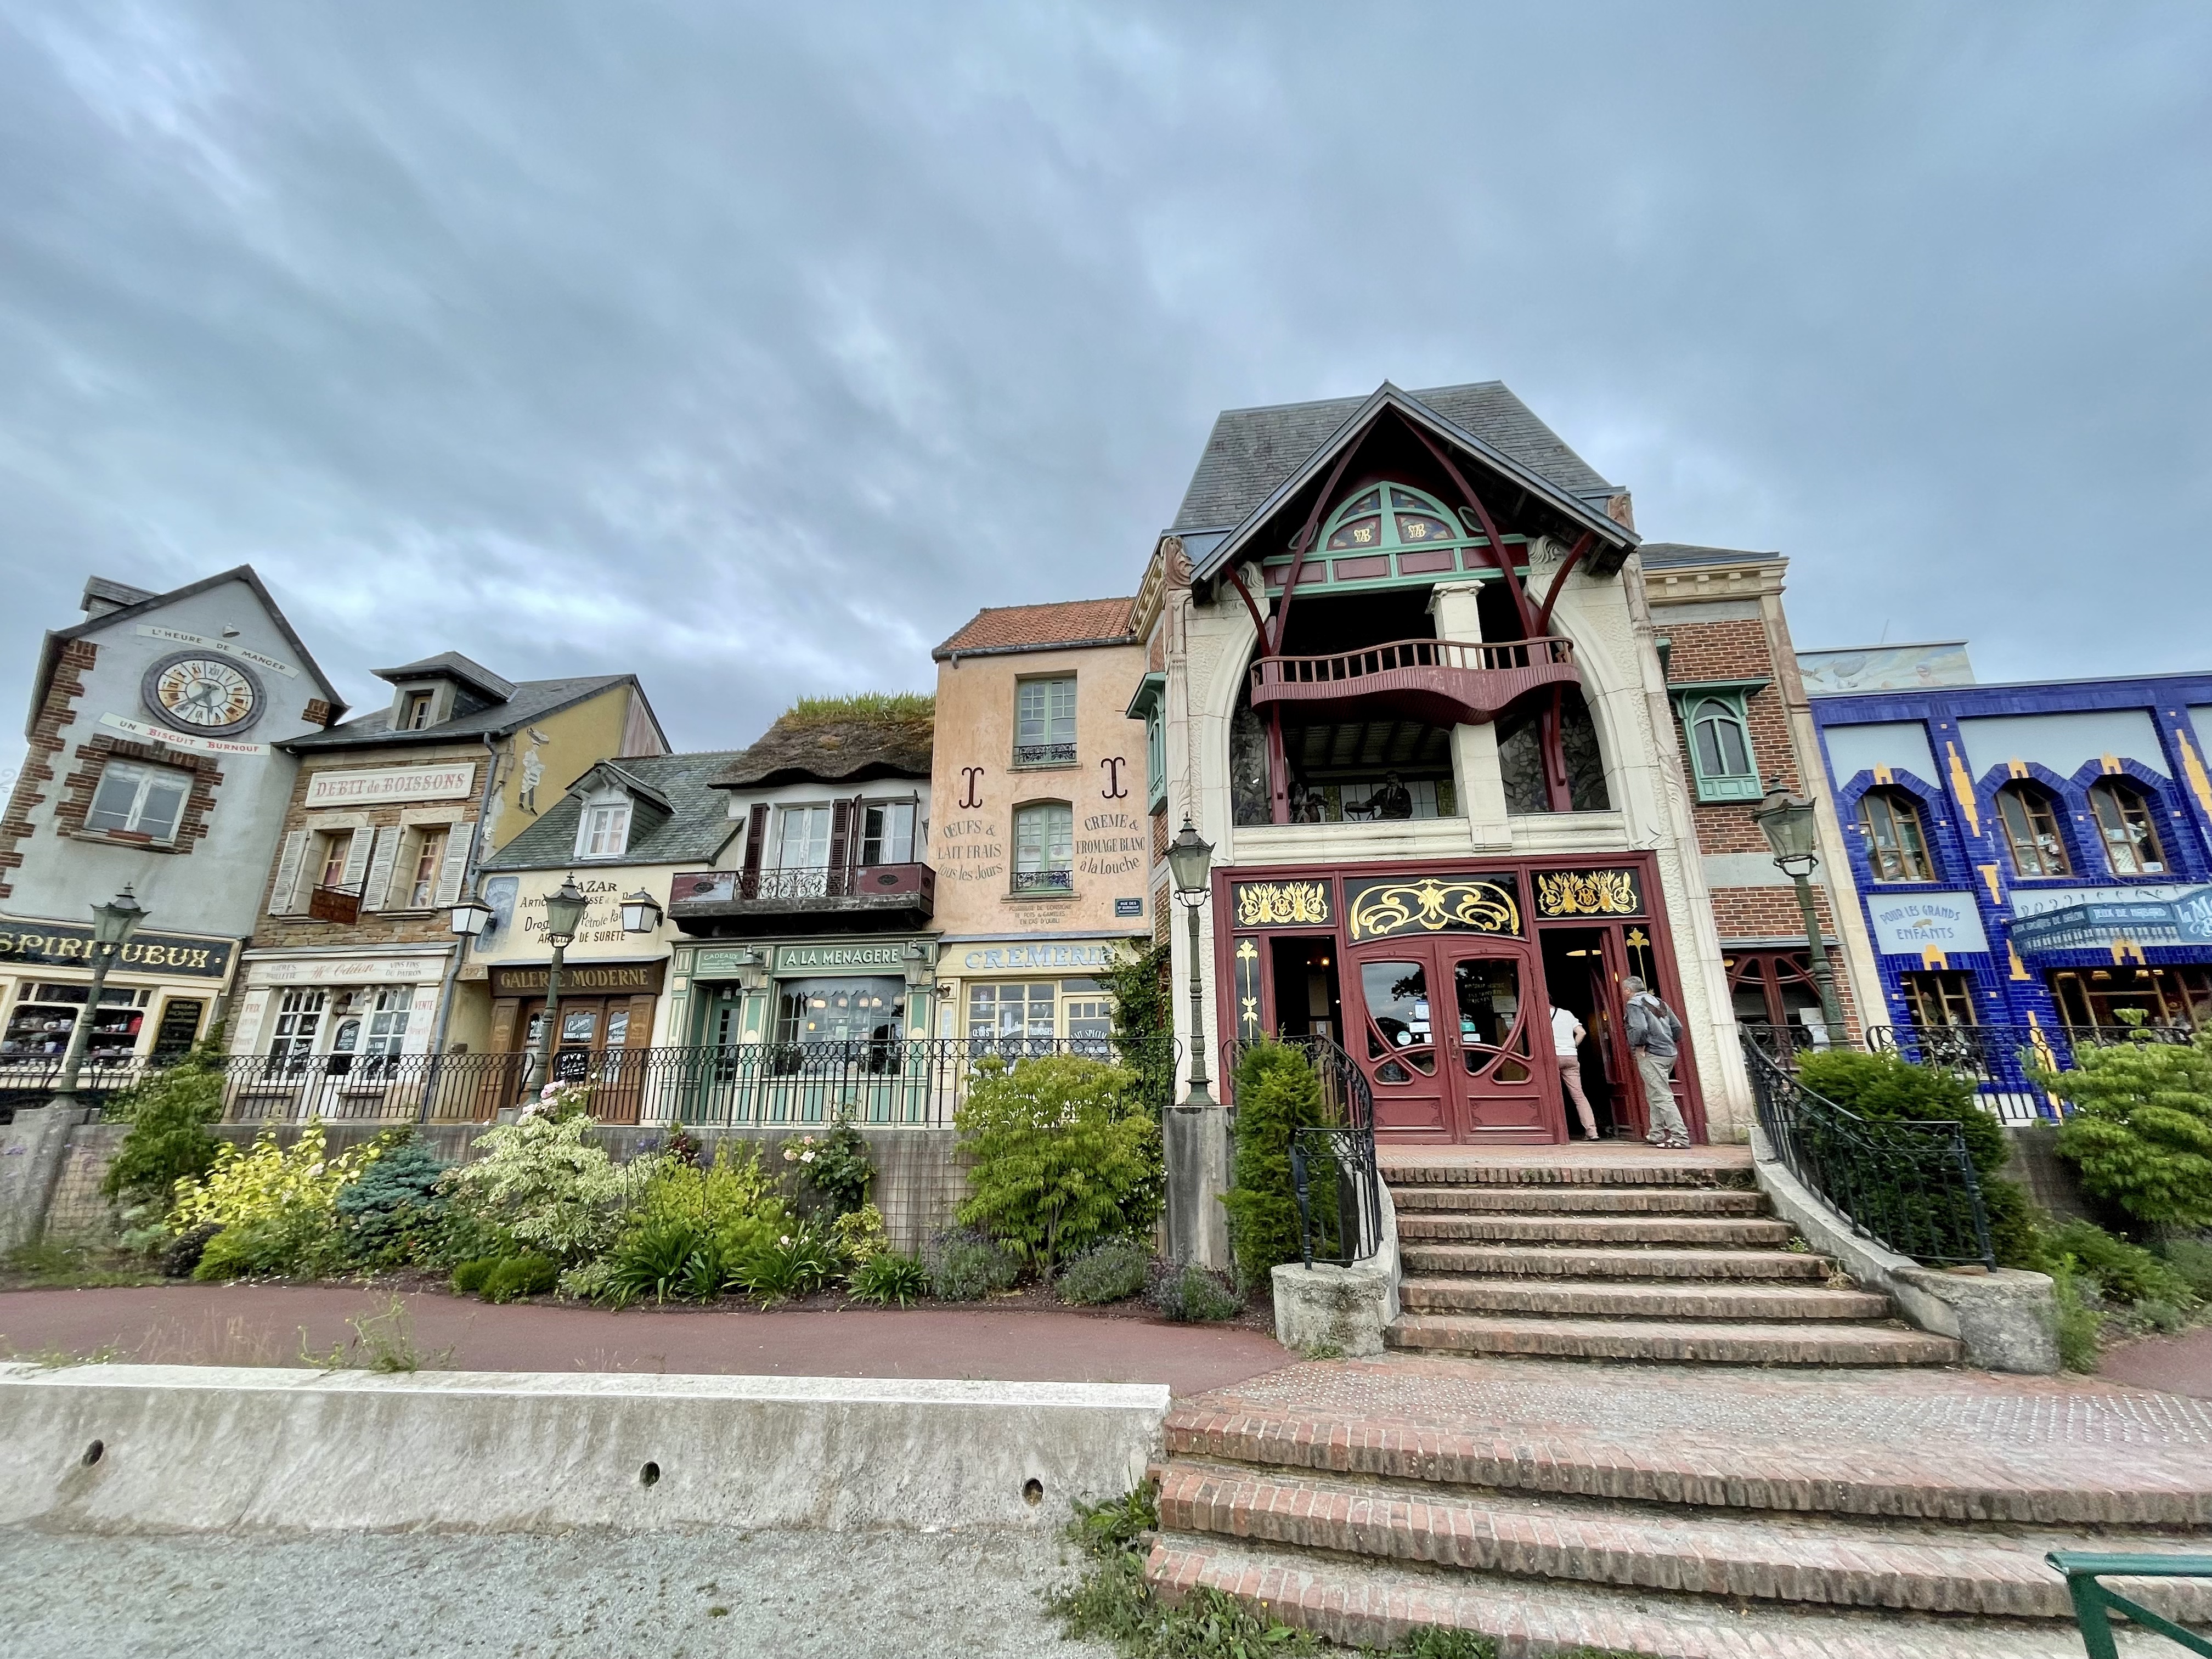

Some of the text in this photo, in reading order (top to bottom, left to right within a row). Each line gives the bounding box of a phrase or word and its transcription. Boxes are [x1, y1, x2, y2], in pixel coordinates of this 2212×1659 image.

[216, 643, 229, 651] DE
[241, 651, 285, 671] MANGER
[120, 720, 260, 752] UN BISCUIT BURNOUF
[317, 773, 466, 796] DEBIT de BOISSONS
[943, 819, 996, 838] ŒUFS &
[1085, 814, 1139, 831] CREME &
[938, 843, 1002, 860] LAIT FRAIS
[1076, 836, 1146, 854] FROMAGE BLANC
[938, 862, 1003, 881] tous les Jours
[1087, 857, 1097, 873] la
[577, 881, 618, 893] AZAR
[1880, 905, 1961, 925] POUR LES GRANDS
[579, 932, 589, 943] DE
[594, 931, 625, 942] SURETE
[1895, 927, 1955, 940] ENFANTS
[0, 932, 210, 969] SPIRIUEUX
[703, 952, 738, 961] CADEAUX
[785, 949, 899, 966] A LA MENAGERE
[334, 963, 374, 977] Odilon
[500, 969, 649, 988] GALERE MODERNE
